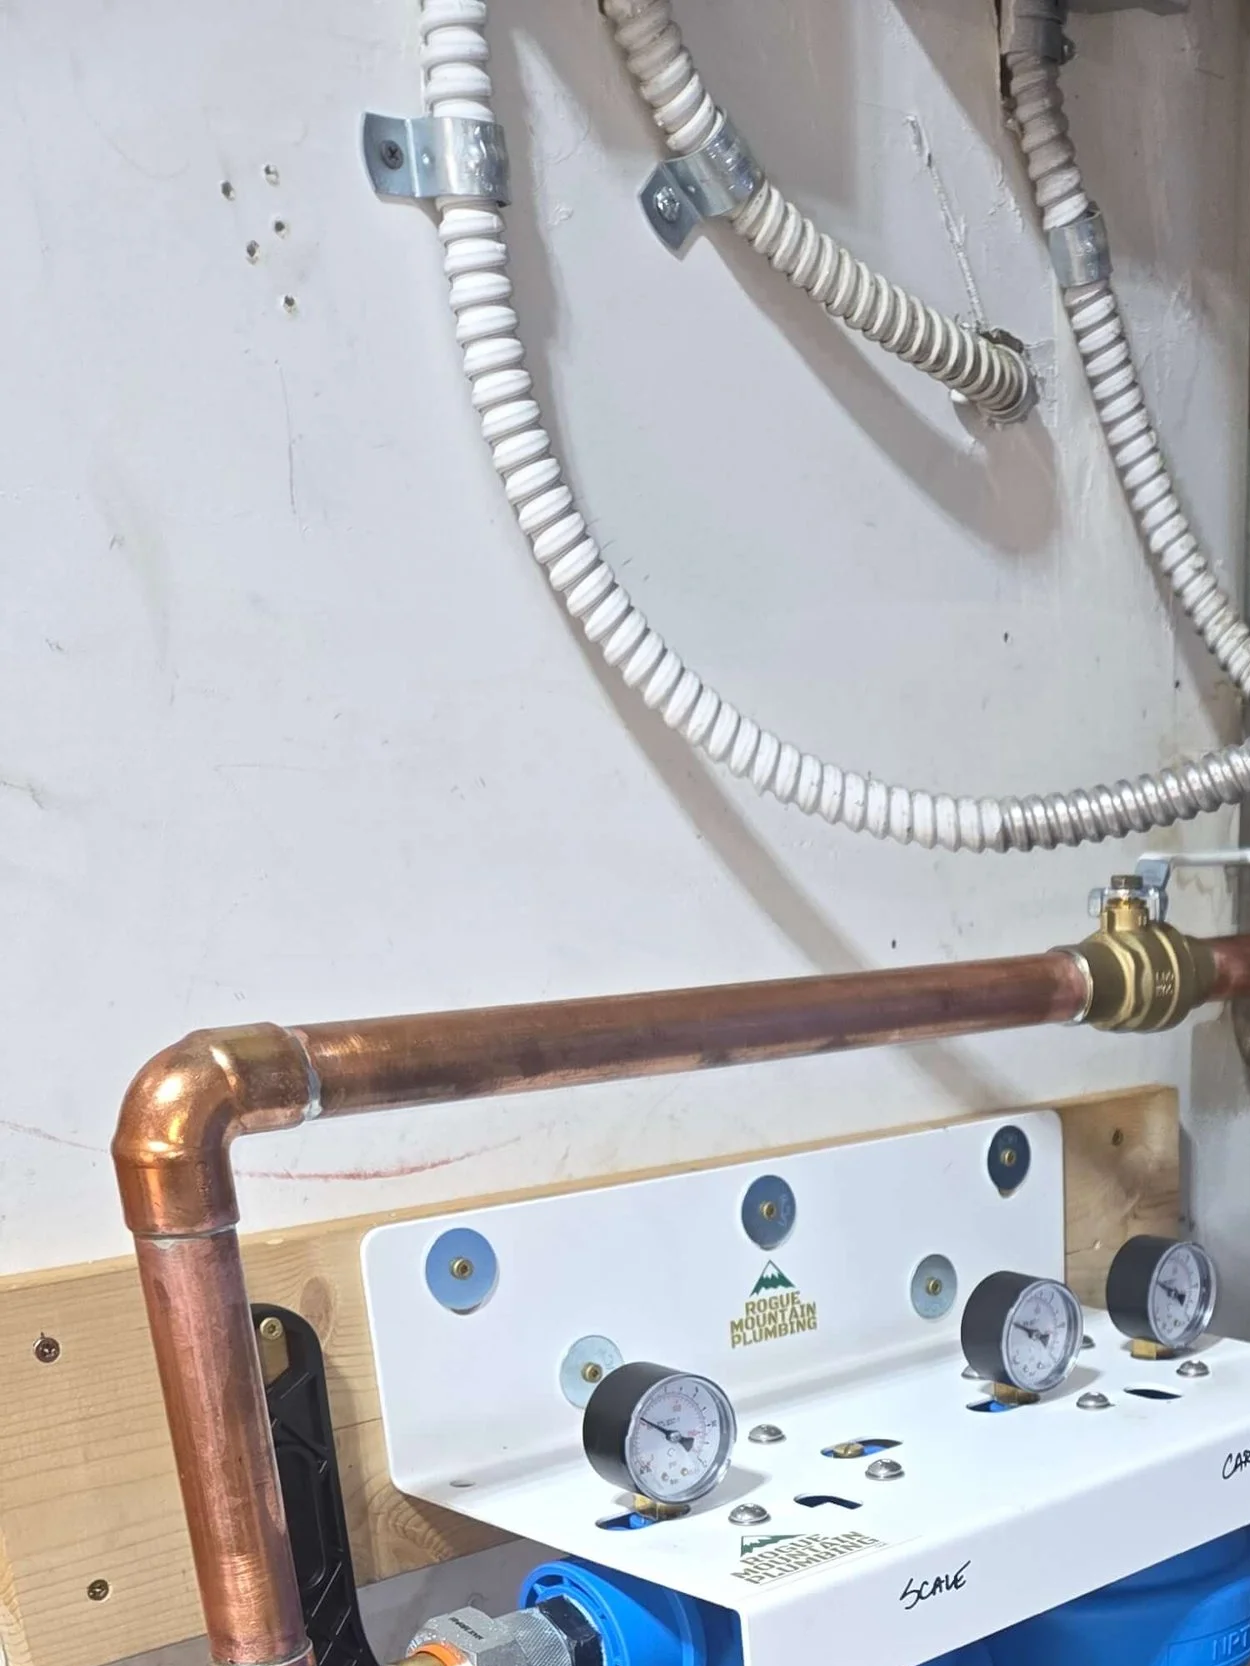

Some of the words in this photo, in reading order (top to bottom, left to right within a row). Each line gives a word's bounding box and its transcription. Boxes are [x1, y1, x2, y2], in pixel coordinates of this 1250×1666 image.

[729, 1300, 817, 1335] MOUNTAIN
[744, 1289, 802, 1317] ROGUE
[731, 1316, 818, 1350] PLUMBING
[729, 1530, 866, 1579] MOUNTAIN
[739, 1533, 830, 1566] ROGUE
[744, 1536, 880, 1585] PLUMBING
[899, 1559, 972, 1611] SCALE
